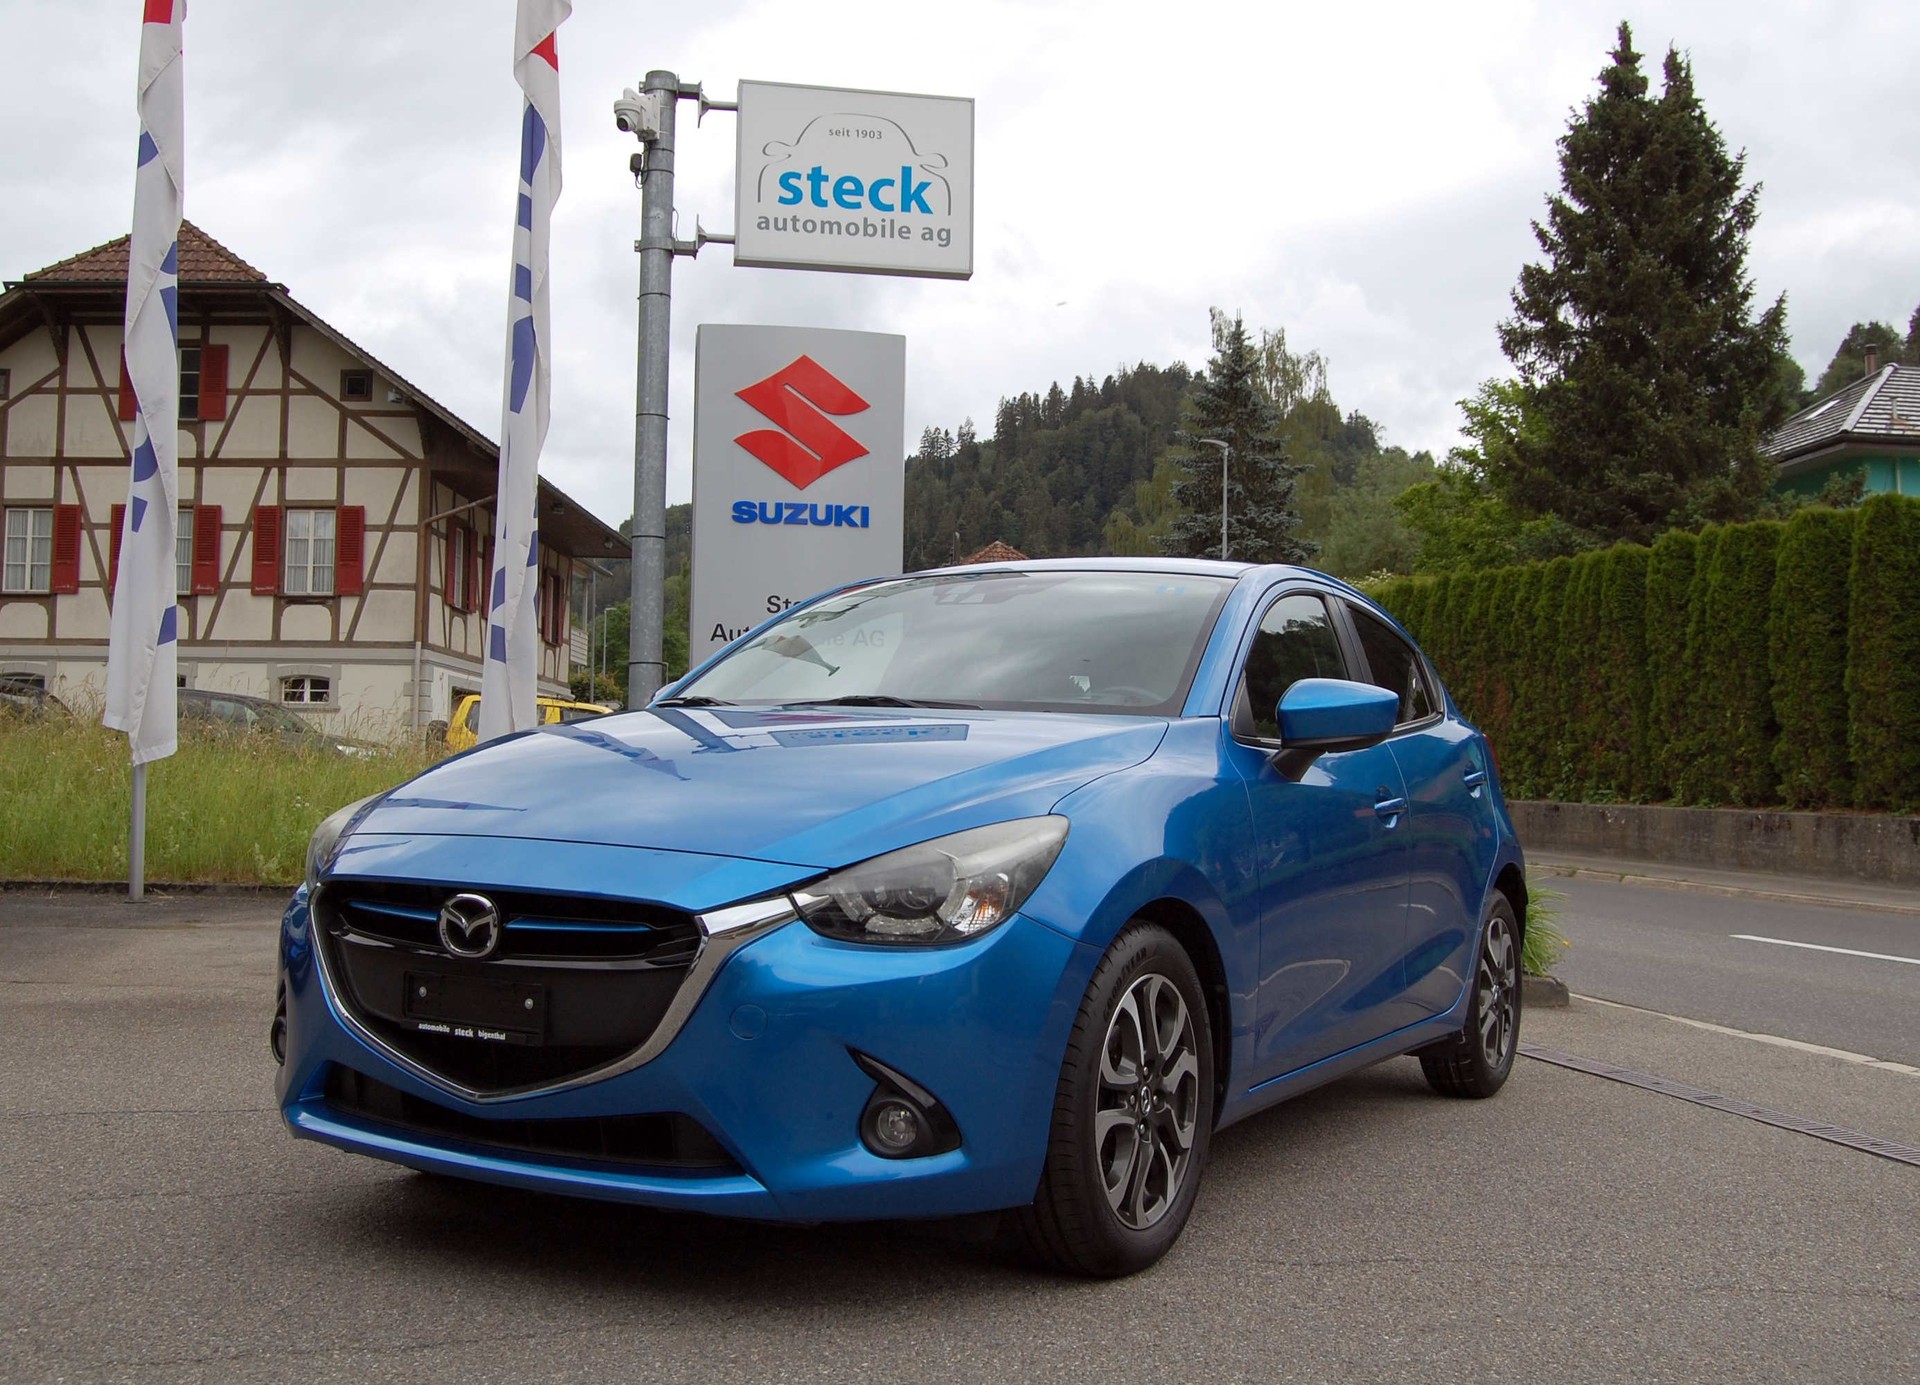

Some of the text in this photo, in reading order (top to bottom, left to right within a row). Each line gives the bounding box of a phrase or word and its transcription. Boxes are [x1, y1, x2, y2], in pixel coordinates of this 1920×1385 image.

[828, 127, 883, 140] seit 1903
[777, 165, 934, 215] steck
[756, 214, 951, 248] automobile ag
[731, 500, 870, 529] SUZUKI
[852, 628, 885, 647] AG
[418, 1023, 506, 1041] automobile steck bigenthal
